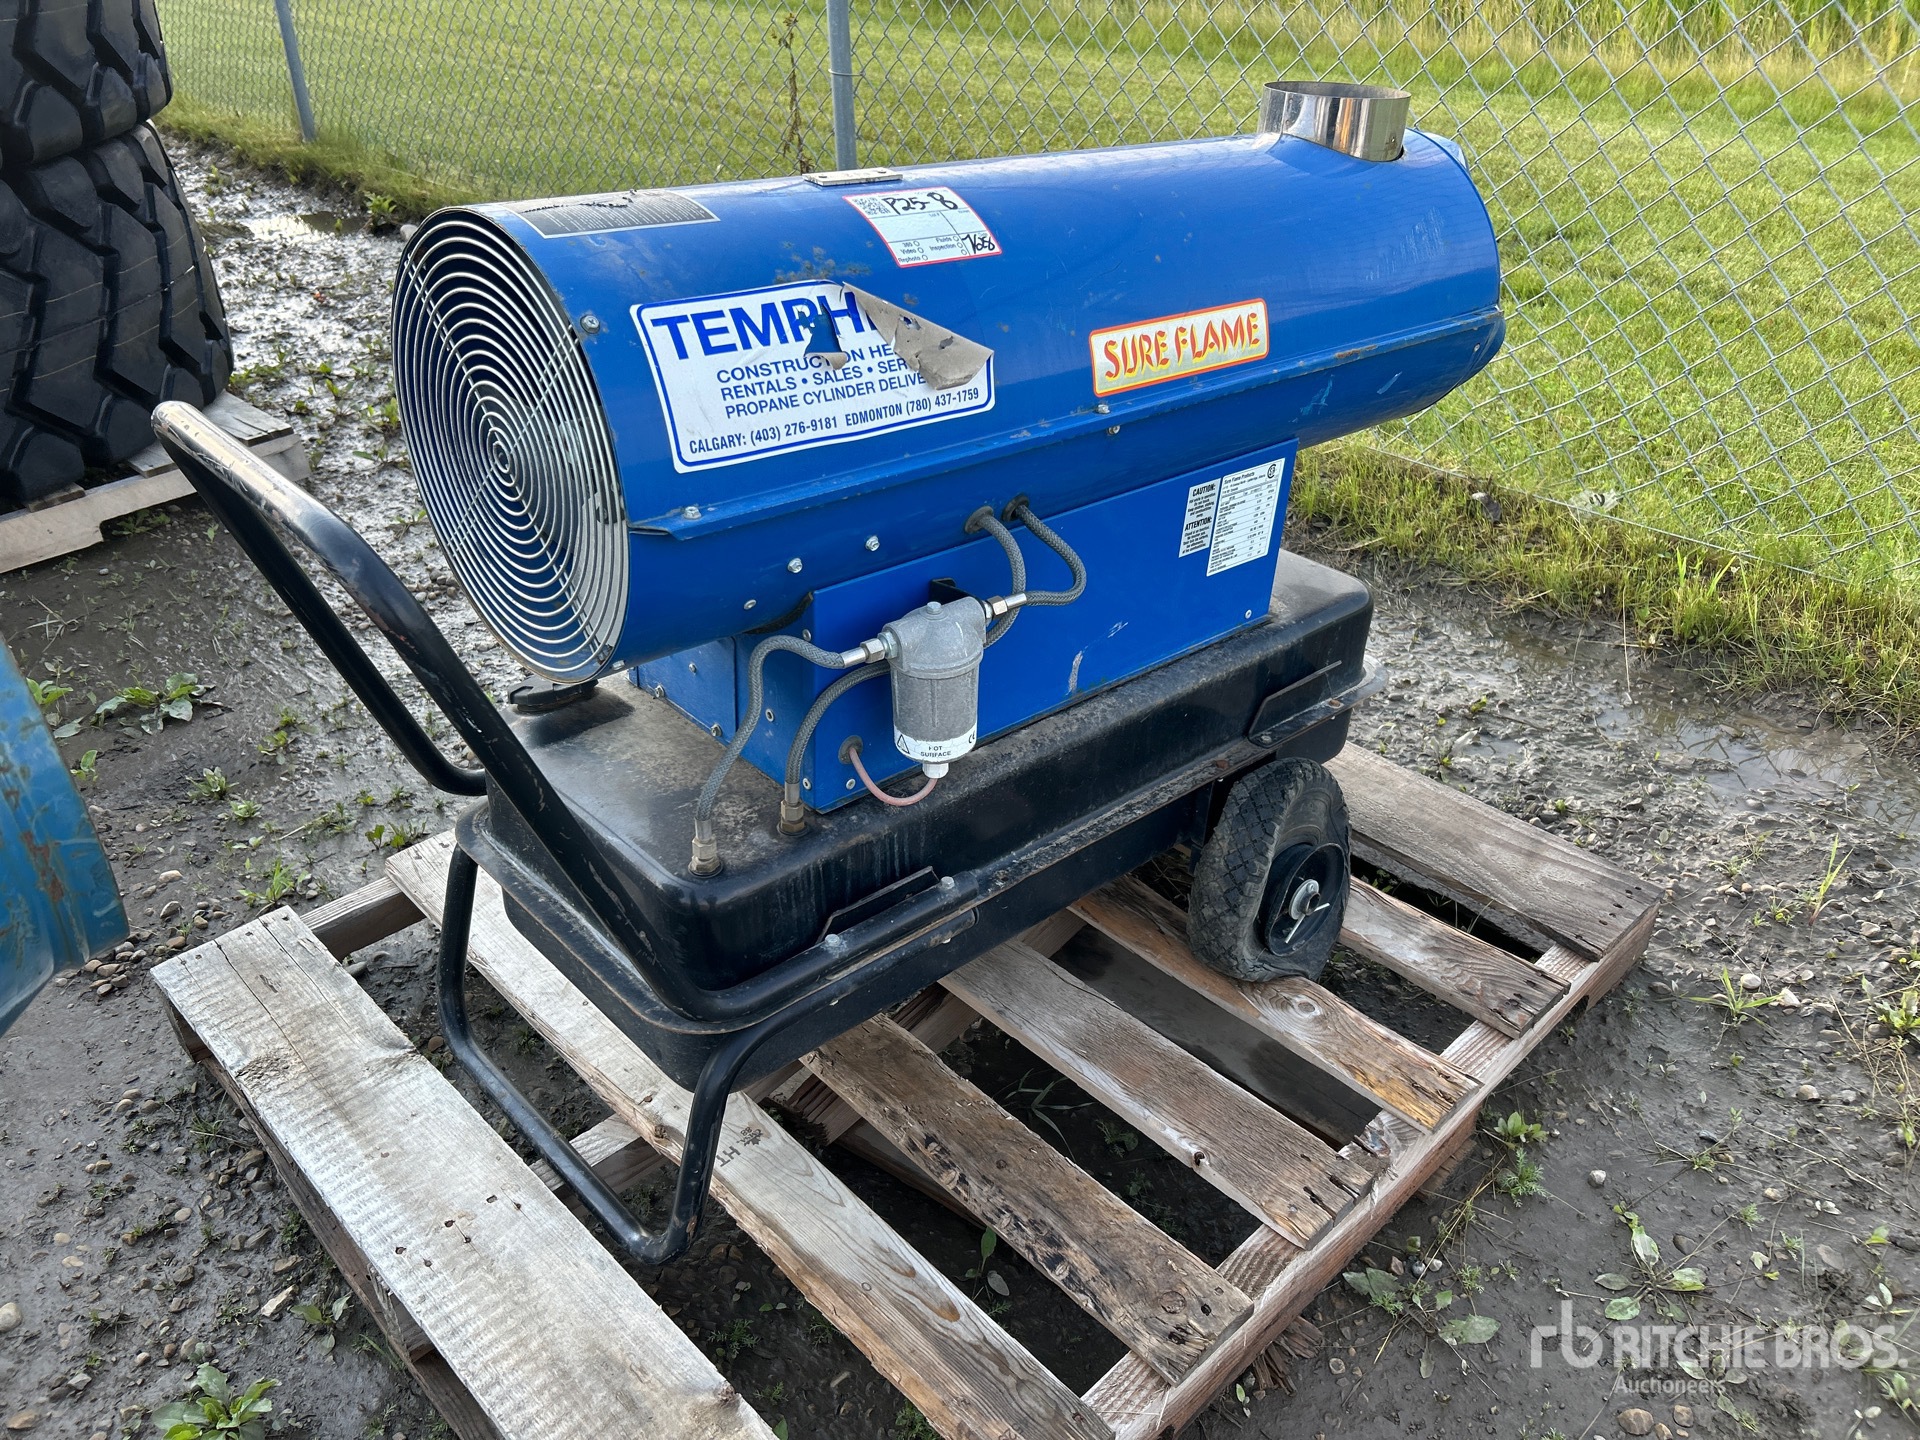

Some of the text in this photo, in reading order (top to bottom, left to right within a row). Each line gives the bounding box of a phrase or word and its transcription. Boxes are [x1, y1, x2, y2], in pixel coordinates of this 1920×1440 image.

[929, 243, 956, 251] Inspection
[1103, 312, 1261, 382] SURE FLAME
[720, 376, 797, 401] RENTALS
[812, 364, 864, 386] SALES
[725, 394, 800, 419] PROPANE
[802, 381, 877, 406] CYLINDER
[689, 387, 979, 454] CALGARY: (403) 276-9181 EDMONTON (780) 437-1759
[1192, 483, 1216, 497] CAUTION:
[1184, 516, 1212, 531] ATTENTION:
[716, 1145, 741, 1167] HT
